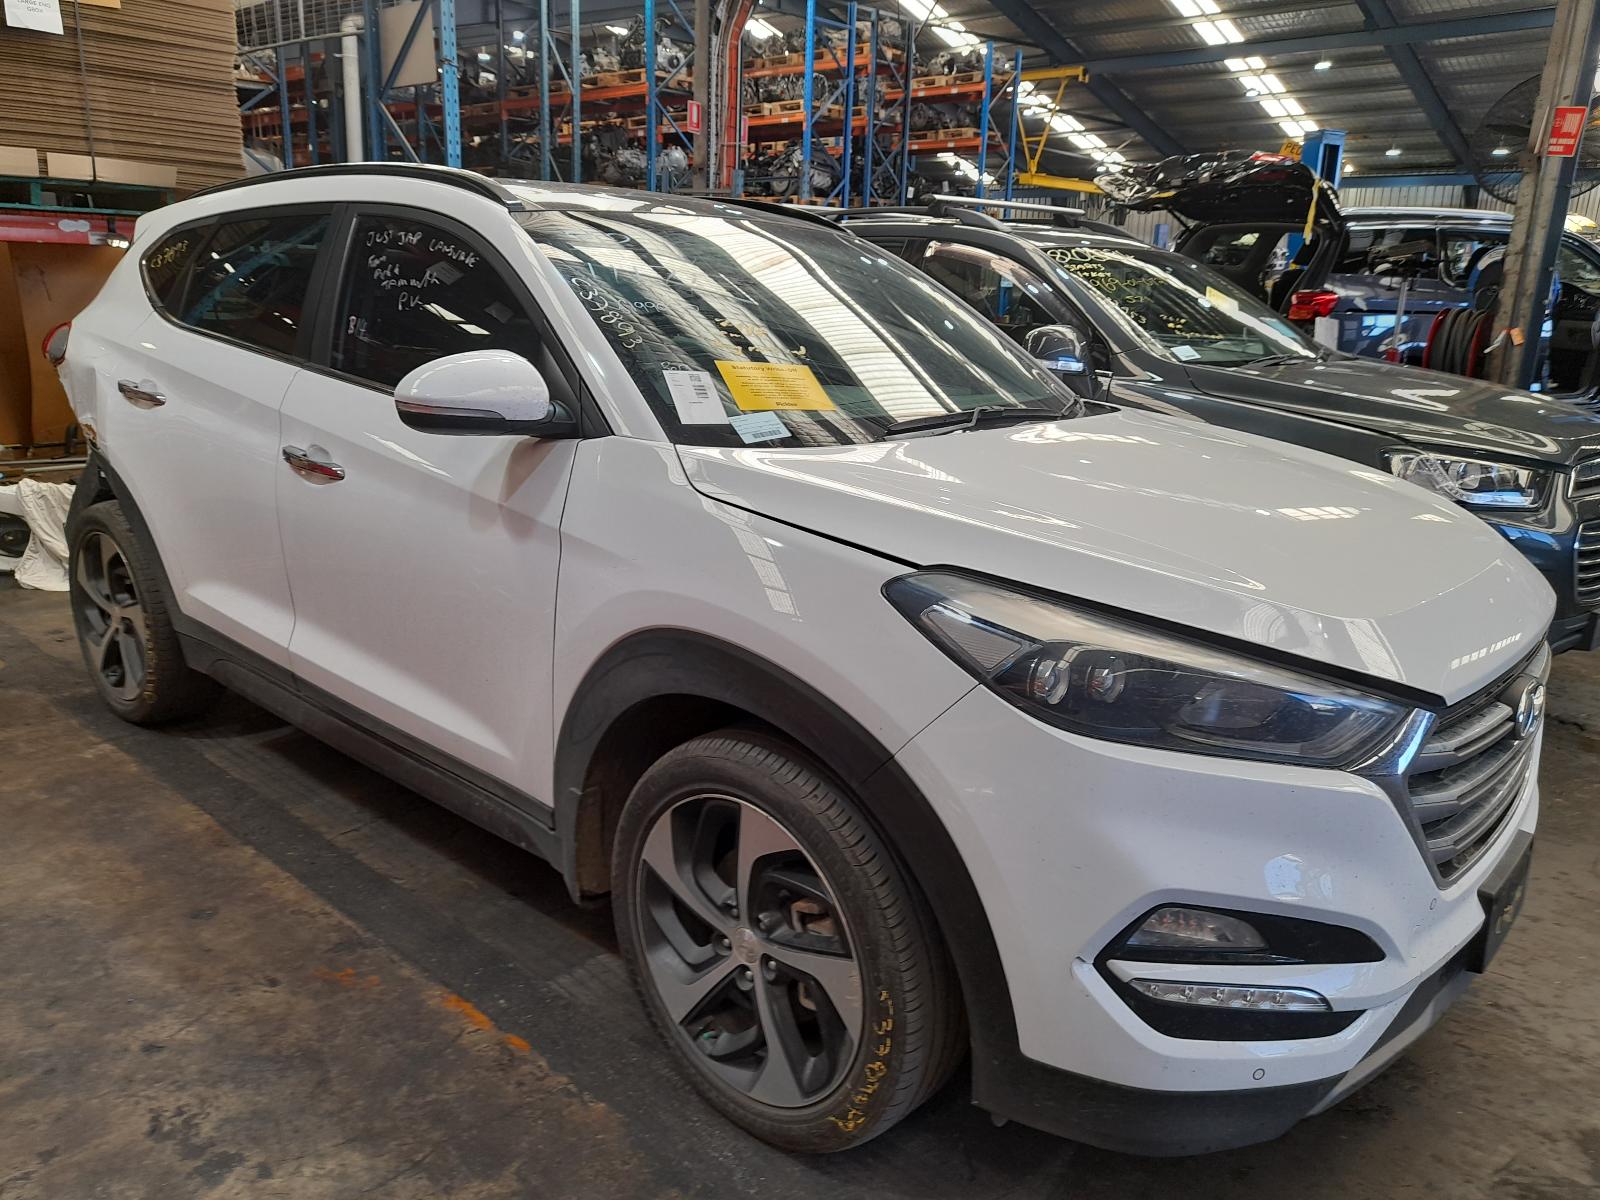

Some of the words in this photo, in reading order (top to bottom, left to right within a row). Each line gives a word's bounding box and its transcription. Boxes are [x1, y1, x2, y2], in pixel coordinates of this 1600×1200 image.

[367, 229, 393, 247] JUST
[398, 231, 422, 246] JAP
[571, 277, 643, 349] C37893
